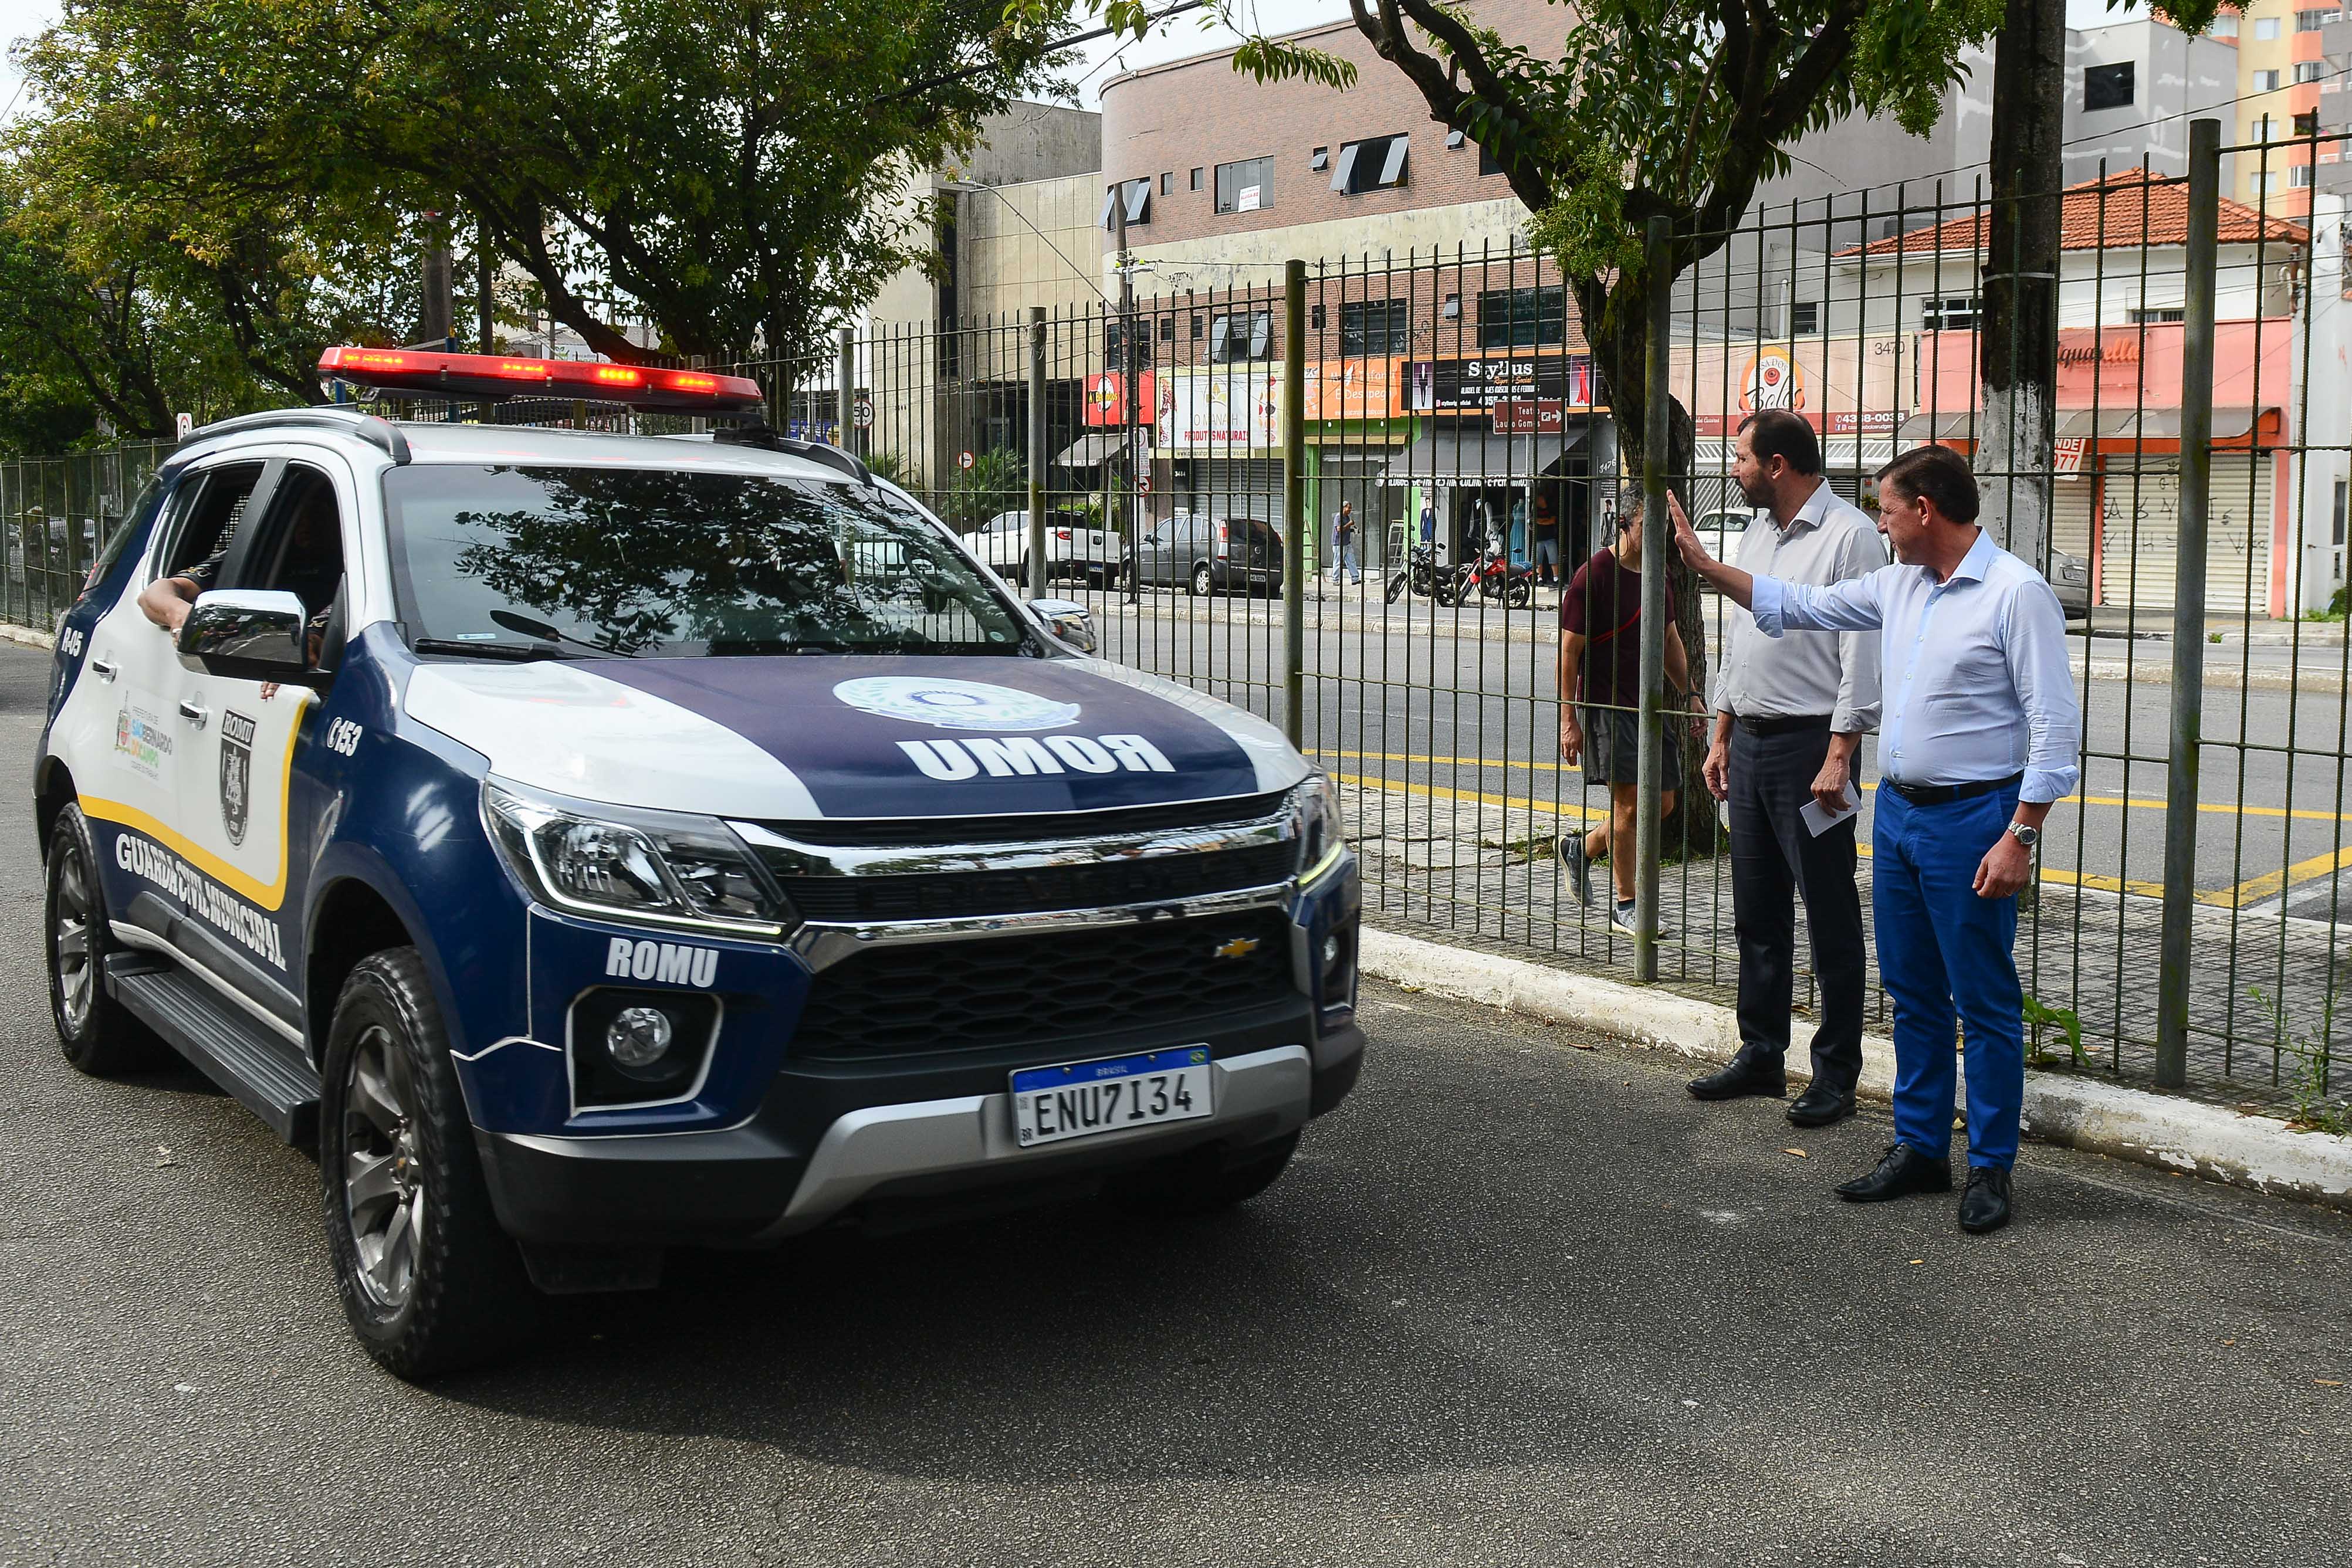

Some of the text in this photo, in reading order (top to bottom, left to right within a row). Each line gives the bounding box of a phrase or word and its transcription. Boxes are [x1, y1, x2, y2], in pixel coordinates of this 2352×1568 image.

[854, 407, 870, 418] 50
[1842, 412, 1905, 423] 438-0038
[1495, 419, 1541, 428] Lauo Goms
[1184, 431, 1216, 441] PRODUTS
[223, 713, 254, 743] ROMU
[116, 833, 287, 972] GUARDA CIVIL MUNICIPAL
[605, 937, 720, 988] ROMU
[1095, 1065, 1129, 1077] BRASIL
[1034, 1073, 1193, 1136] ENU7I34
